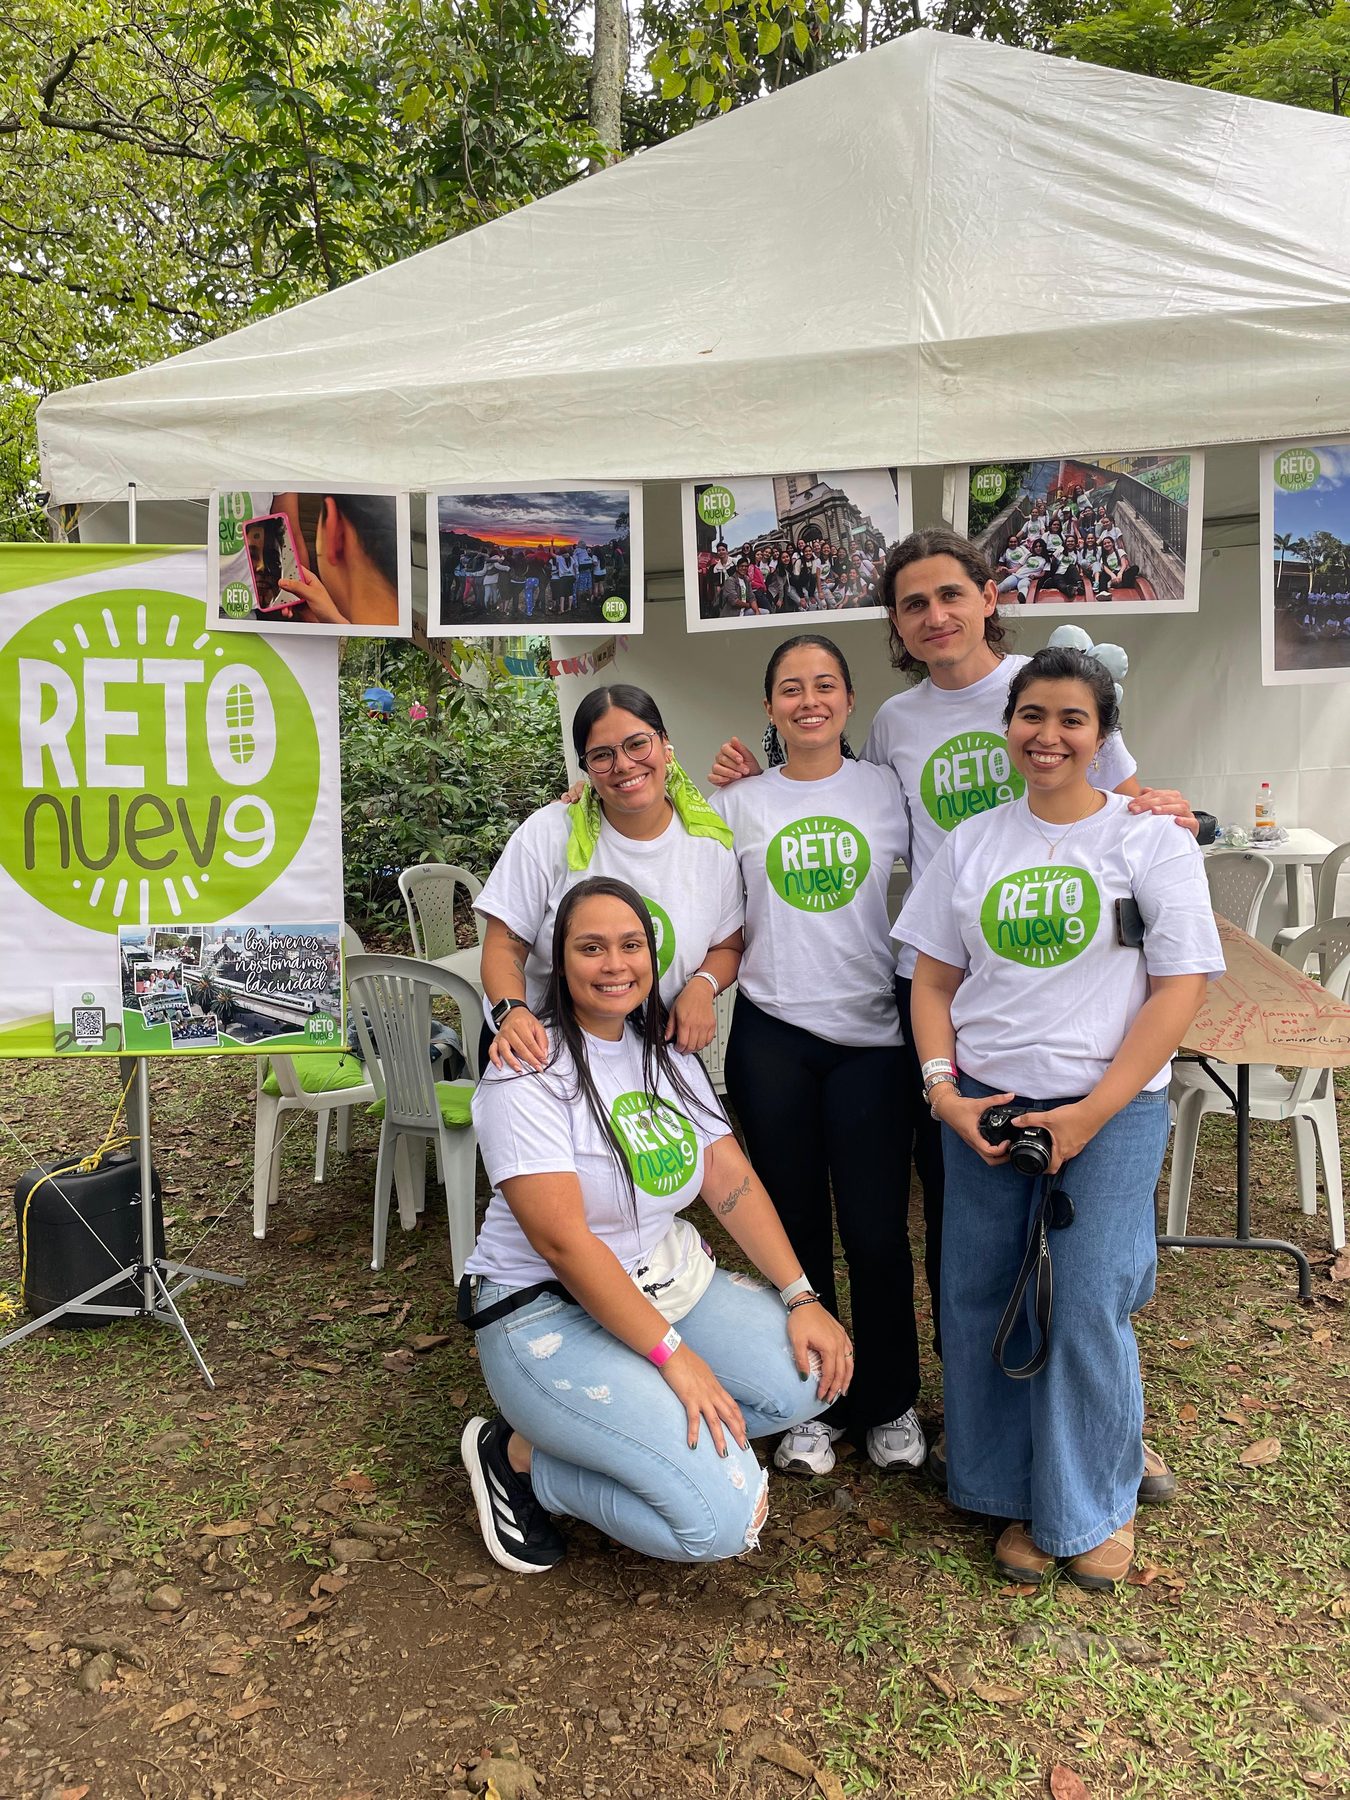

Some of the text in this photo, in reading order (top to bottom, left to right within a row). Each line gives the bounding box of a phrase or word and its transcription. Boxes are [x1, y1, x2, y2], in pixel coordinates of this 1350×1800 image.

[1280, 455, 1315, 475] RETO
[977, 473, 1003, 488] RETO
[703, 493, 730, 510] RETO
[226, 588, 249, 603] RETO
[605, 601, 624, 612] RETO
[18, 657, 277, 788] RETO
[933, 746, 1011, 796] RETO
[780, 831, 858, 872] RETO
[997, 877, 1084, 921] RETO
[244, 928, 265, 953] los
[235, 952, 328, 974] nos tomamos
[245, 971, 327, 994] la ciudad
[310, 1019, 334, 1033] RETO
[616, 1106, 685, 1154] RETO
